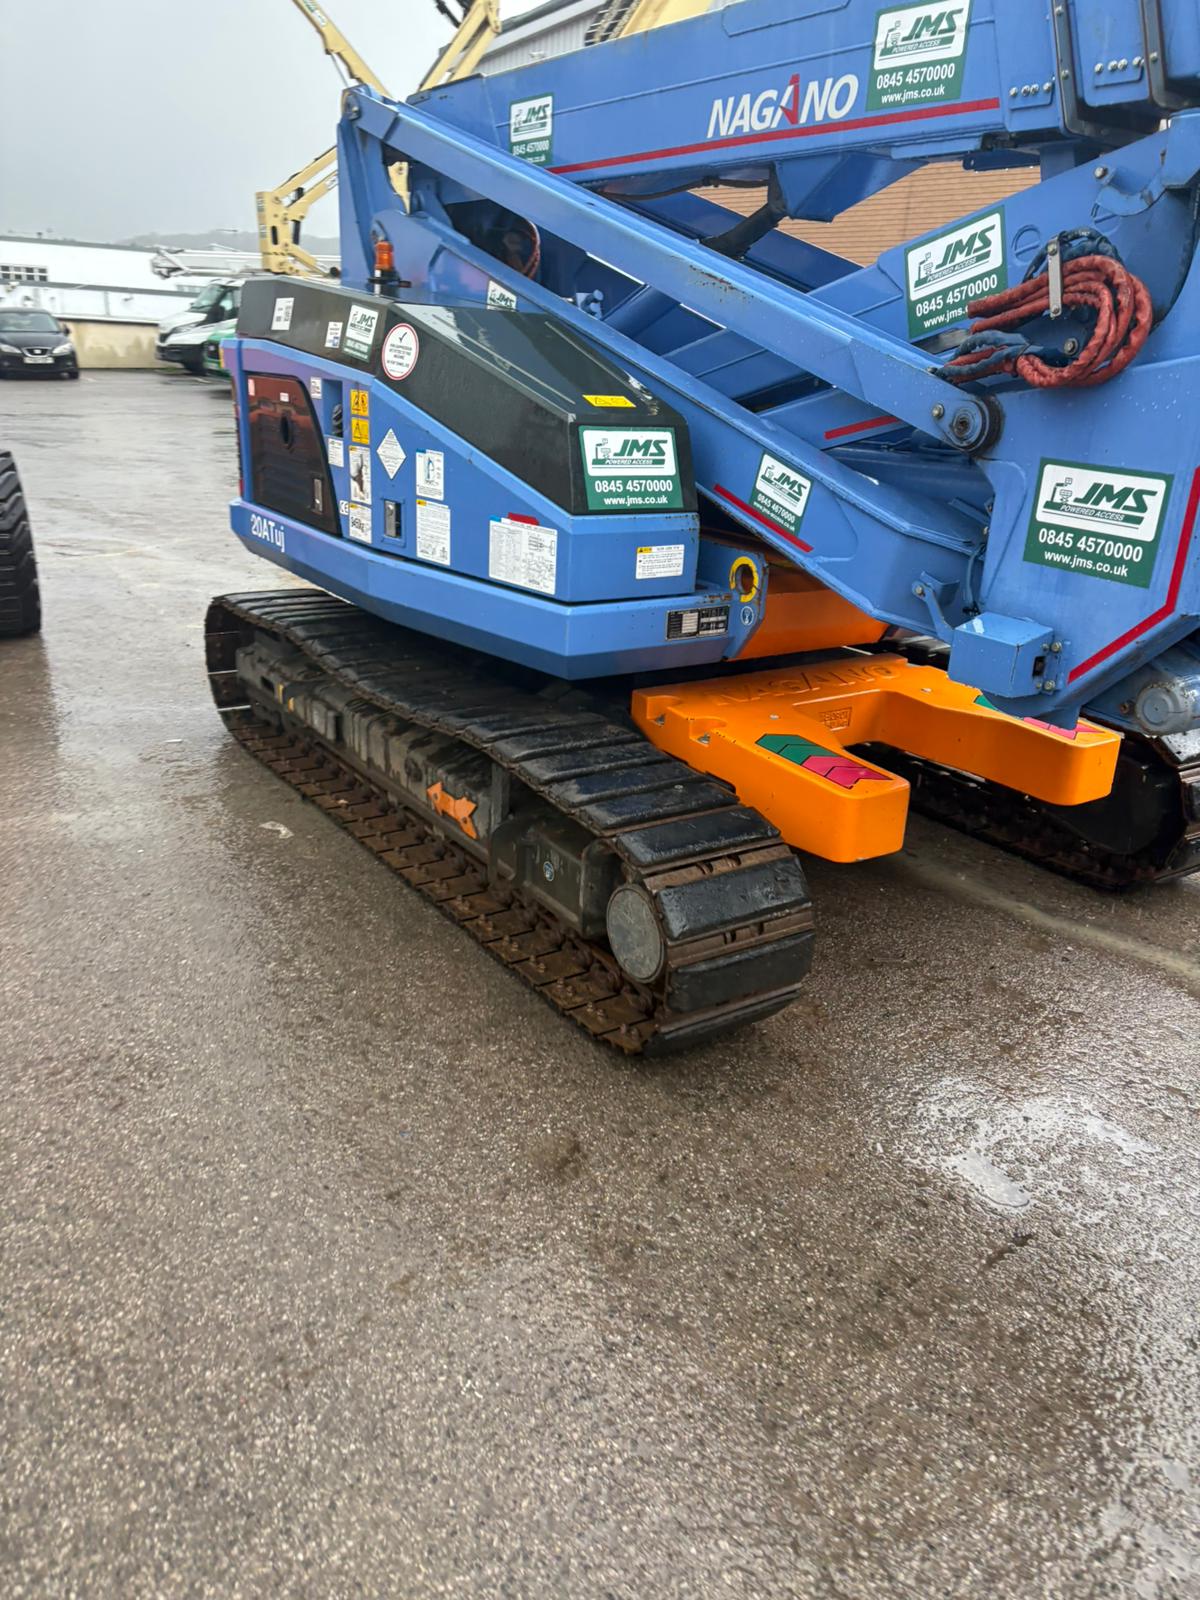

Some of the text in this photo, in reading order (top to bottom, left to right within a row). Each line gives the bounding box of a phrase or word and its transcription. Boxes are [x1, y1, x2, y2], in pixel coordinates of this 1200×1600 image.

[901, 8, 964, 41] JMS
[892, 39, 941, 54] POWERED ACCESS
[876, 63, 955, 89] 0845 4570000
[707, 74, 859, 138] NAGANO
[881, 84, 945, 104] www.jms.co.uk
[522, 103, 550, 124] JMS
[935, 224, 996, 270] JMS
[916, 274, 998, 317] 0845 4570000
[357, 313, 375, 328] JMS
[612, 438, 668, 457] JMS
[594, 480, 673, 493] 0845 4570000
[773, 472, 807, 497] JMS
[603, 495, 668, 507] www.jms.co.uk
[1073, 482, 1158, 514] JMS
[1060, 504, 1125, 521] POWERED ACCESS
[1038, 528, 1143, 562] 0845 4570000
[1044, 550, 1128, 577] www.jms.co.uk
